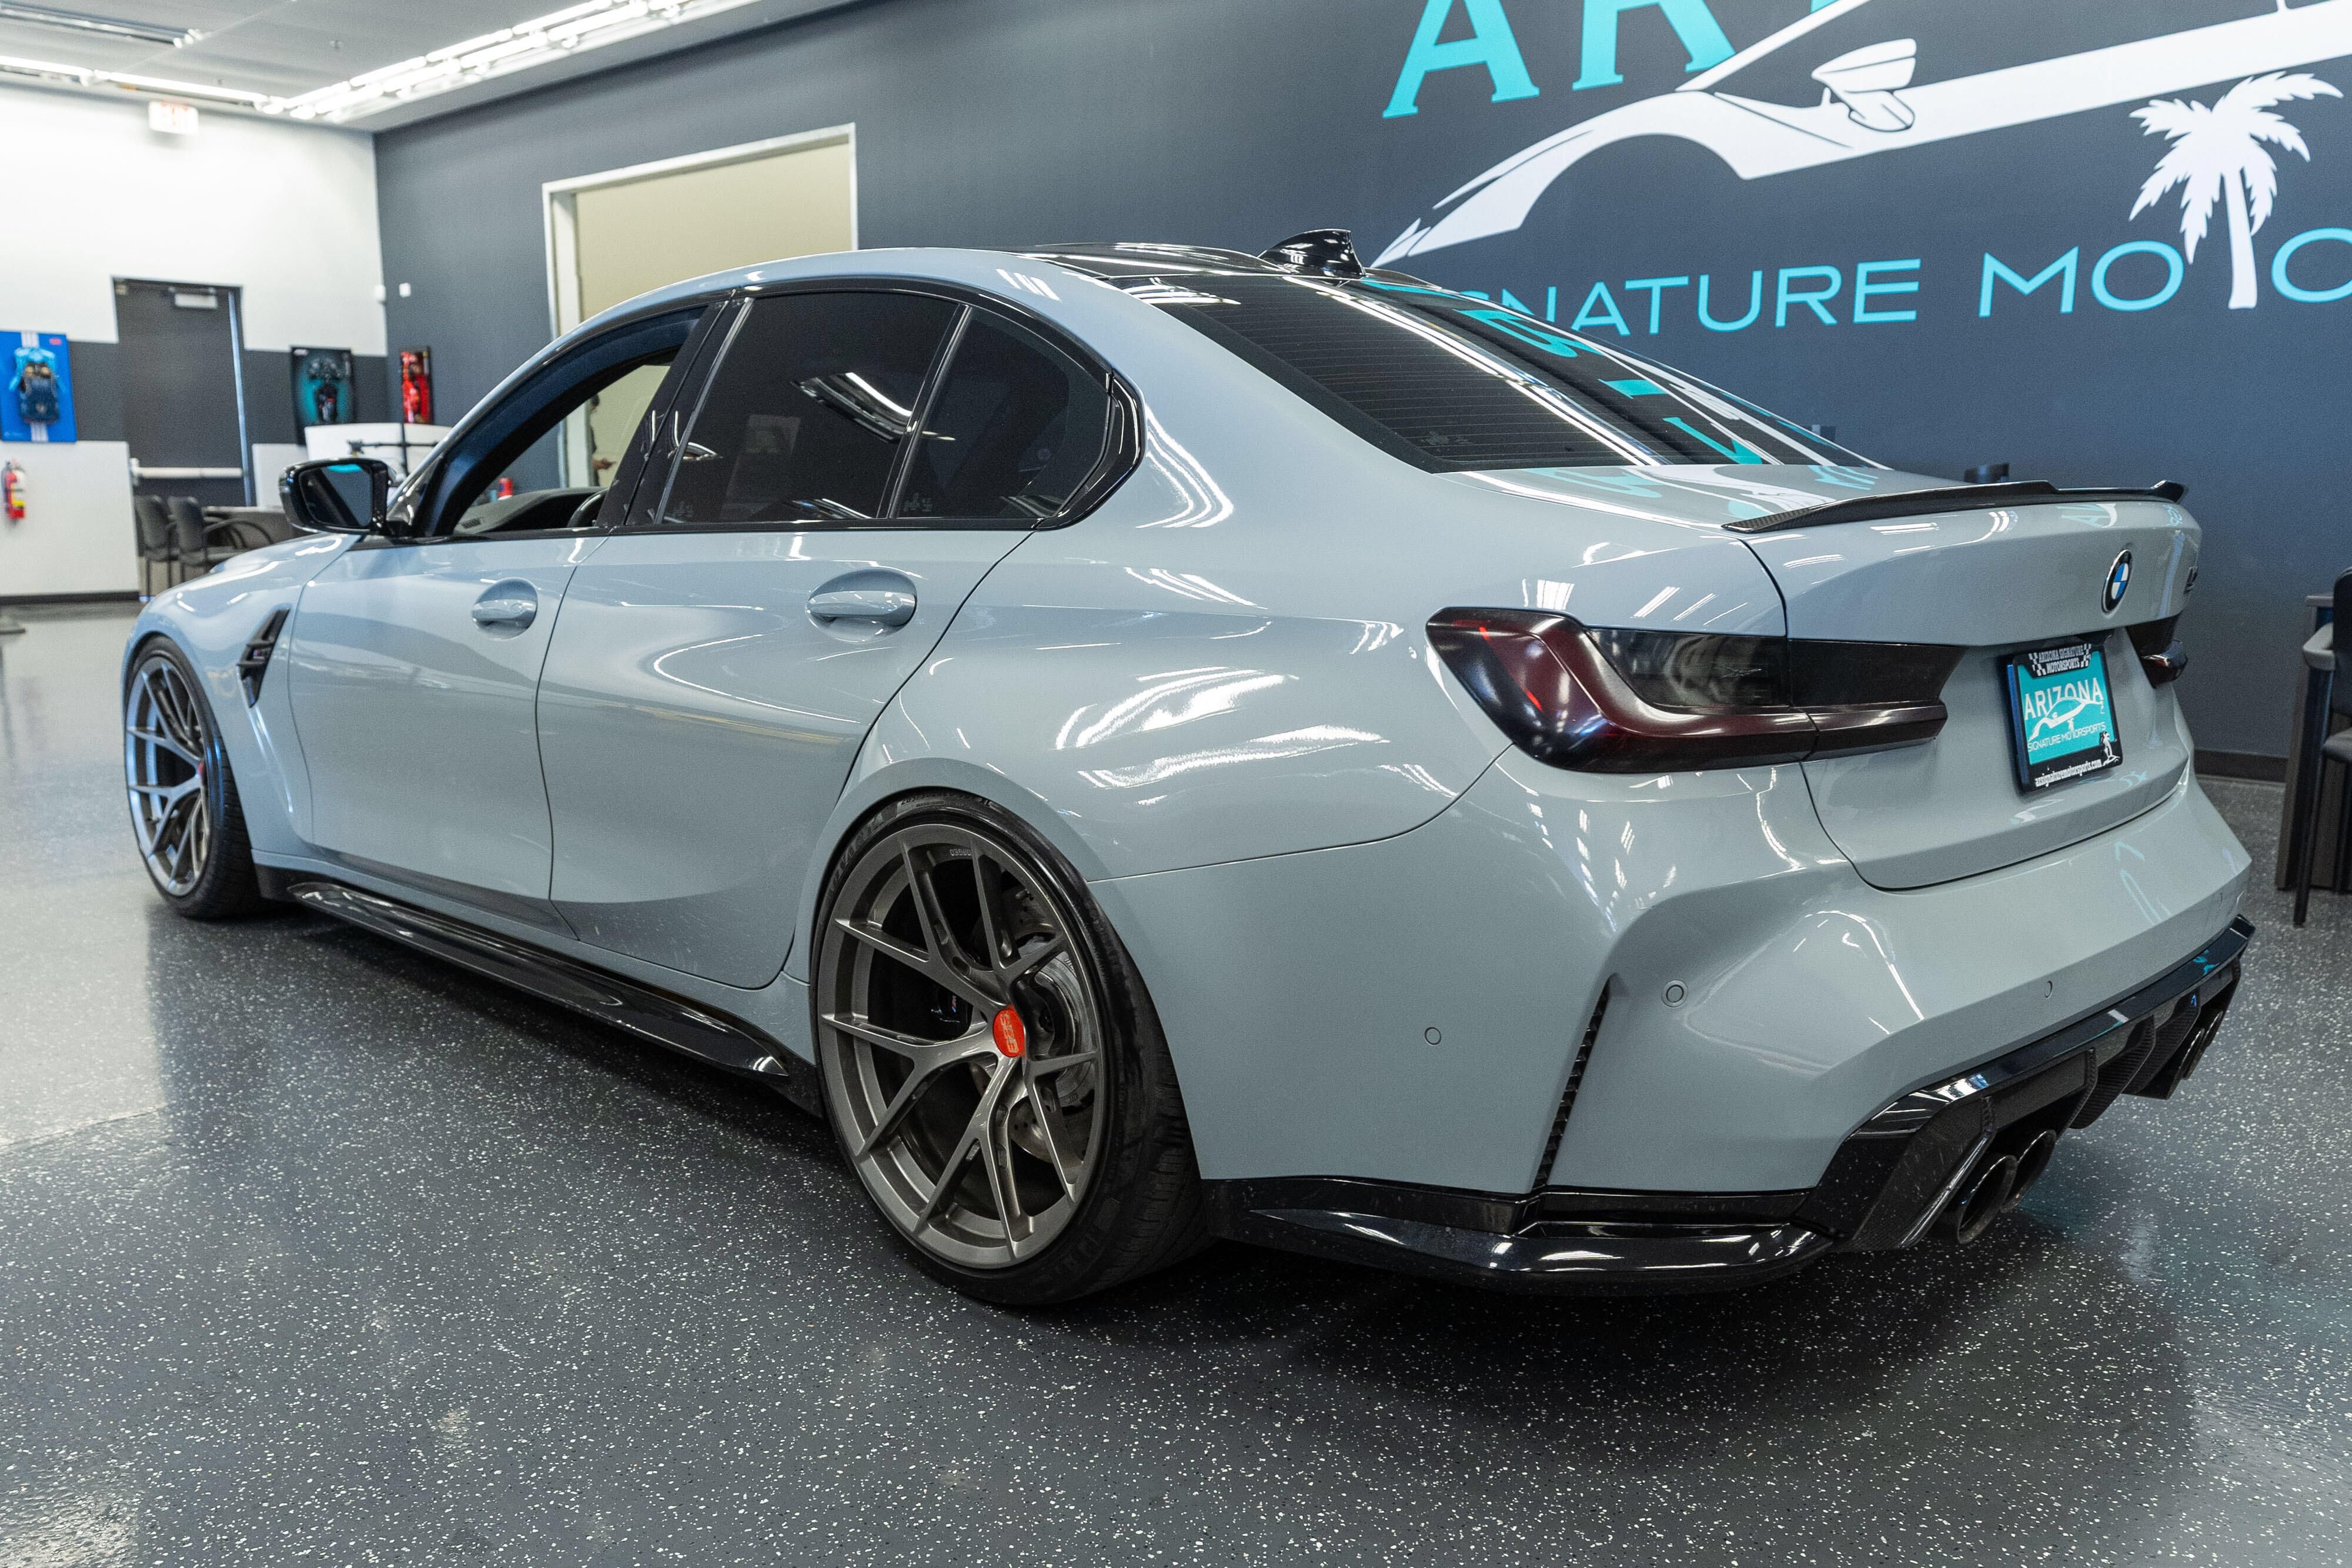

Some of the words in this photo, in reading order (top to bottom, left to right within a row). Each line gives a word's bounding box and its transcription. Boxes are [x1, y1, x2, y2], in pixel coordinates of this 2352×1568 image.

[1382, 0, 1838, 118] AR
[2039, 649, 2059, 663] ARIZONA
[2059, 645, 2084, 659] SIGNATURE
[2046, 657, 2080, 674] MOTORSPORTS
[2024, 677, 2104, 721] ARIZONA
[2027, 735, 2061, 753] SIGNATURE
[2034, 758, 2103, 787] azsignaturemotorsports.com
[1000, 1011, 1019, 1054] BBS
